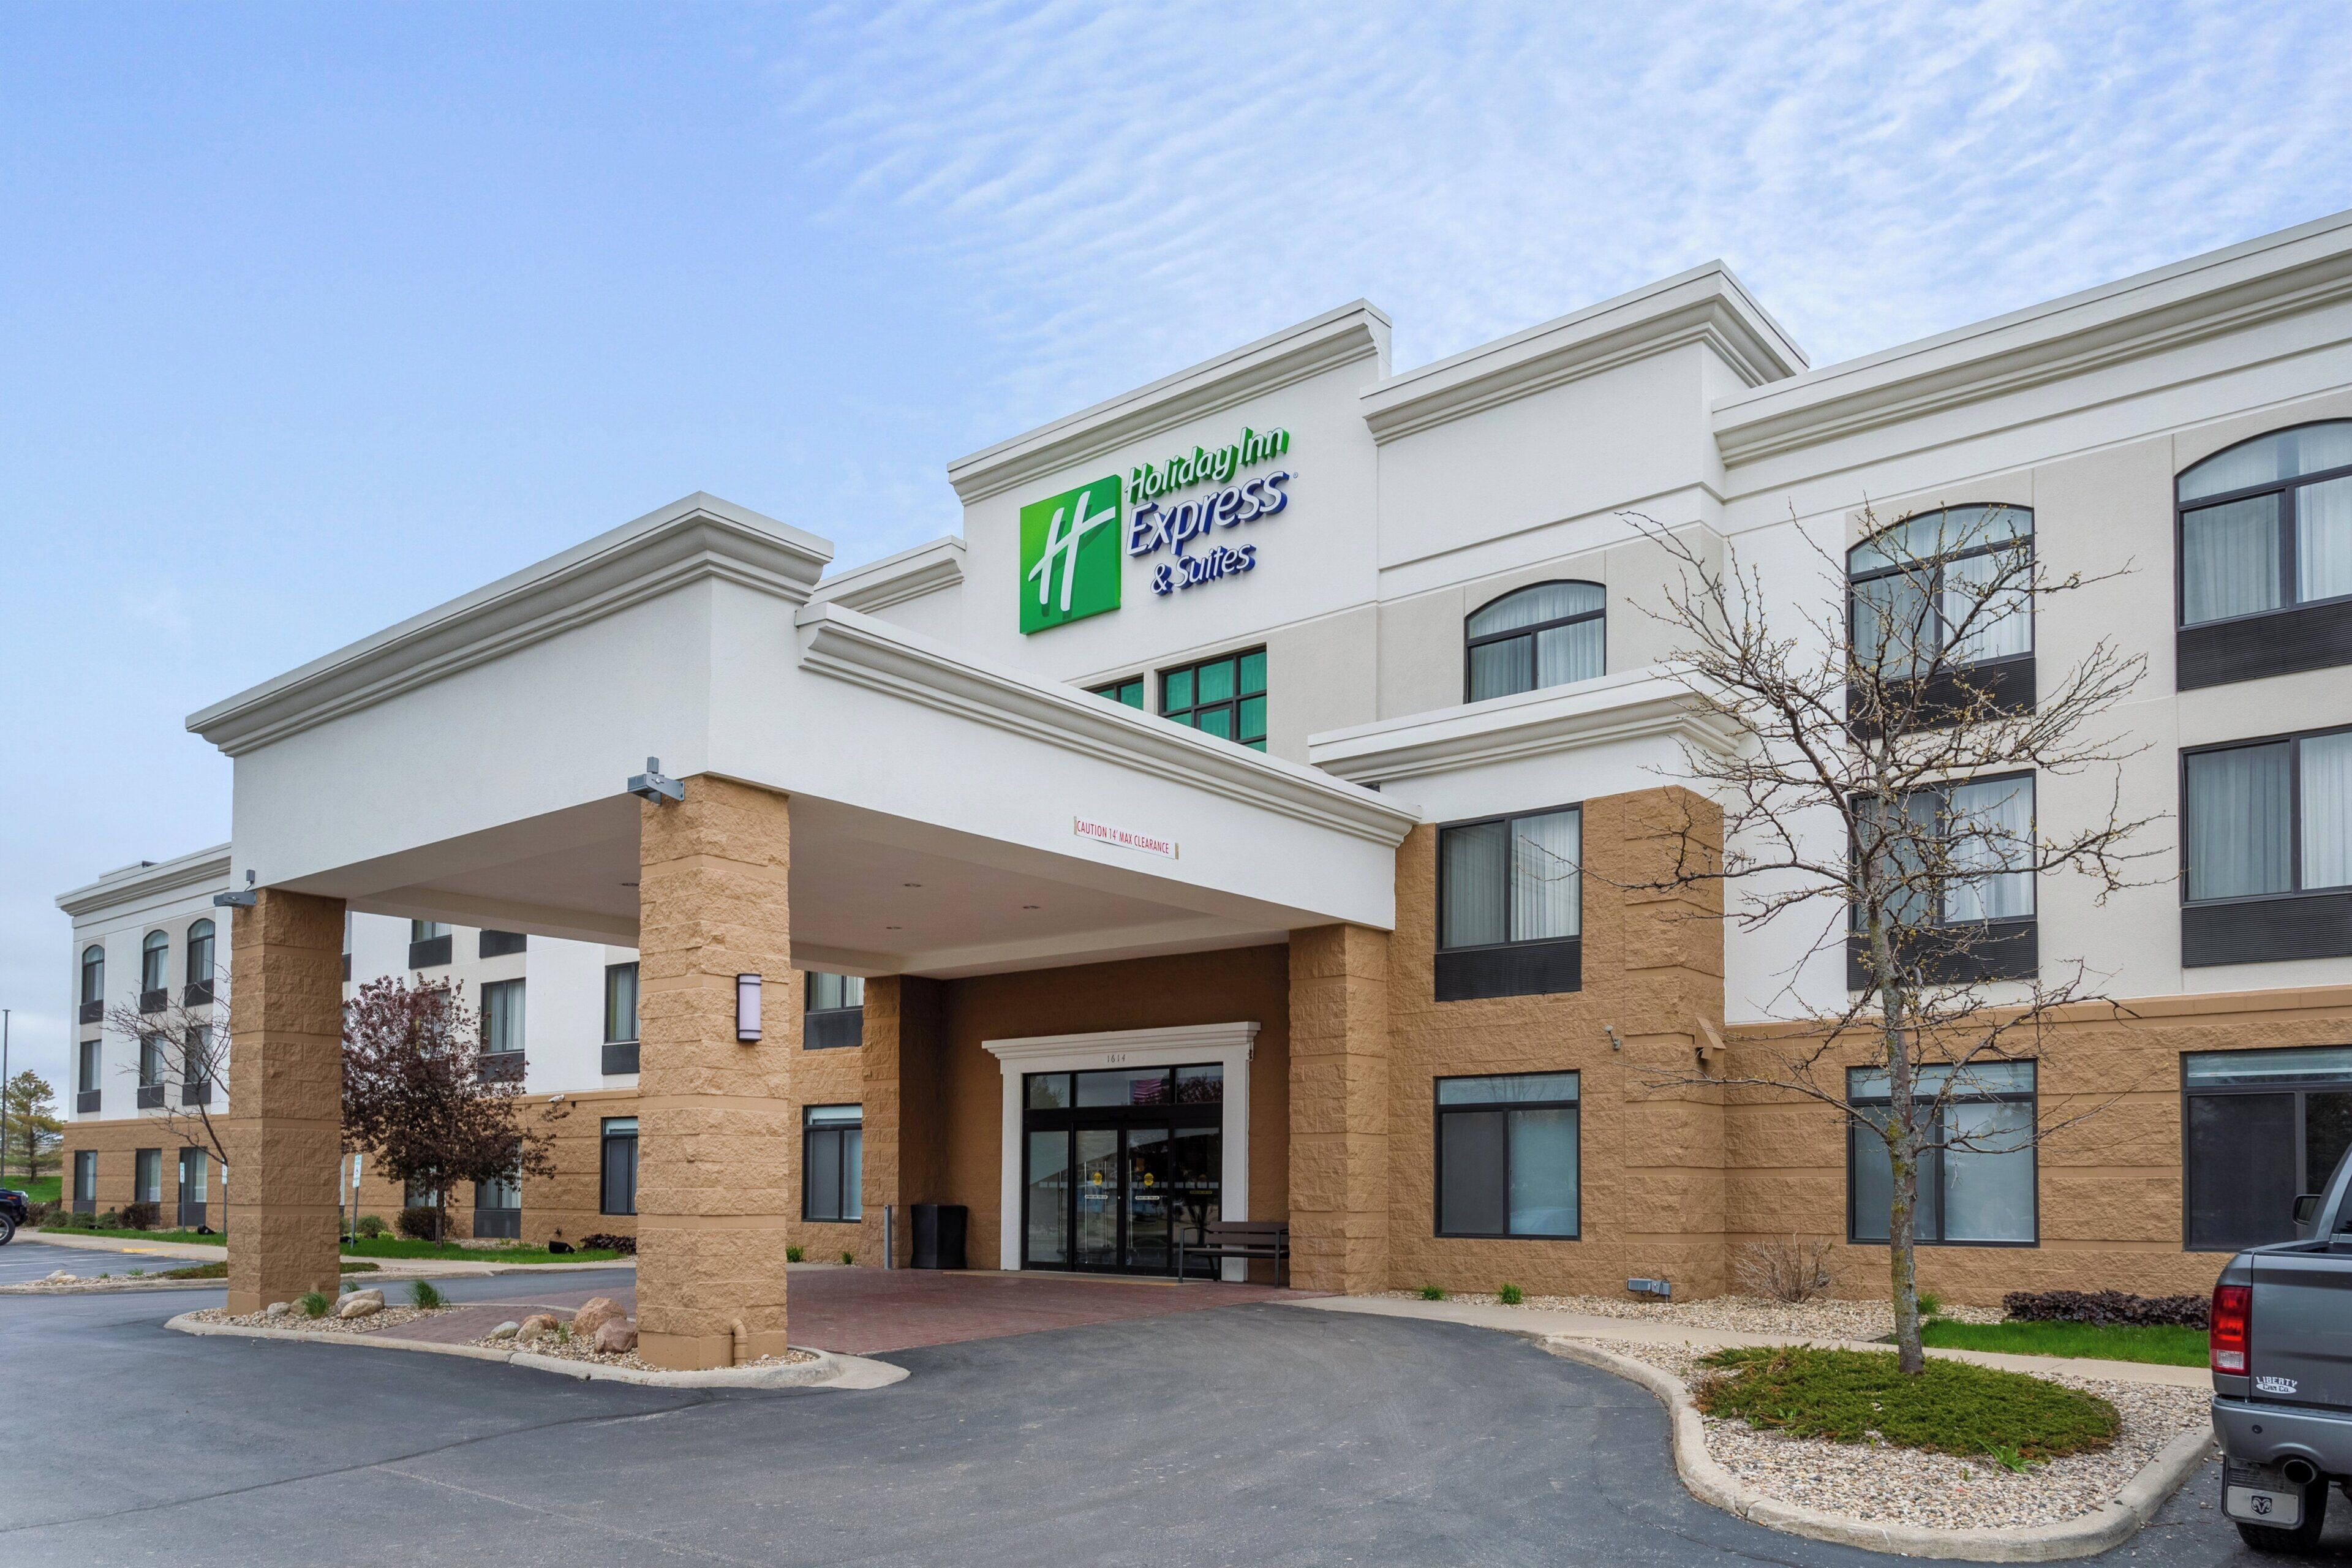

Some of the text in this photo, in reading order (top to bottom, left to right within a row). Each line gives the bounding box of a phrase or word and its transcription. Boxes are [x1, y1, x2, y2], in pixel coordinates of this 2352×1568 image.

[1125, 426, 1290, 505] Holiday Inn
[1126, 470, 1290, 557] Express
[1150, 544, 1257, 596] & Suites
[1077, 820, 1107, 839] CAUTION
[1119, 831, 1133, 845] MAX
[1134, 835, 1169, 854] CLEARANCE
[1107, 1054, 1125, 1063] 1614
[2256, 1376, 2297, 1387] LIBERTY
